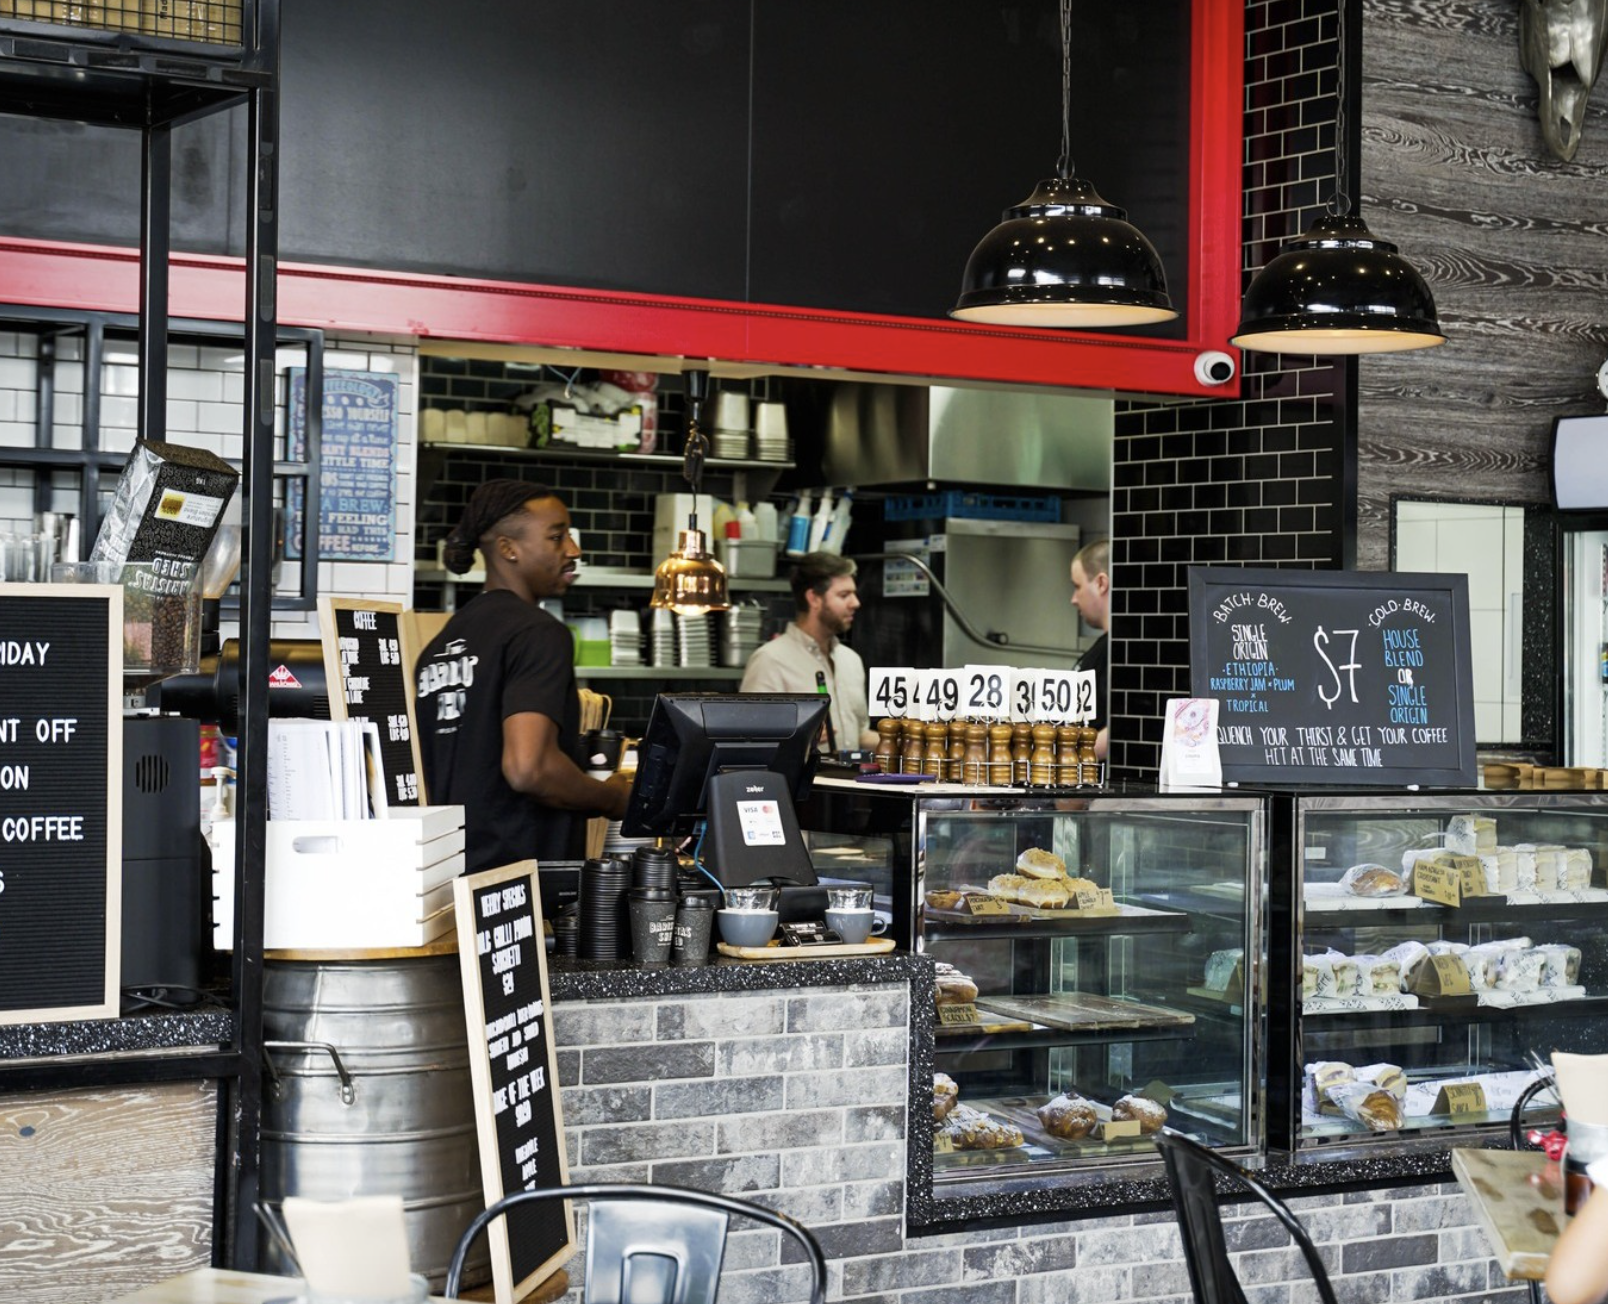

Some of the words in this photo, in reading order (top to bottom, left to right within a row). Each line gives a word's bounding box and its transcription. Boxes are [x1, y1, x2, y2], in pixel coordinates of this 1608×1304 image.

[1213, 592, 1251, 624] BATCH
[1257, 592, 1291, 625] BREW
[1369, 599, 1399, 627] COLD
[1403, 598, 1436, 624] BREW
[1231, 624, 1268, 642] SINGLE
[1383, 629, 1421, 649] HOUSE
[1233, 642, 1268, 660] ORIGIN
[1385, 650, 1424, 668] BLEND
[1313, 625, 1362, 710] $7
[876, 676, 908, 709] 45
[926, 678, 959, 711] 49
[968, 674, 1003, 708] 28
[1041, 678, 1071, 713] 50
[1210, 677, 1249, 691] RASPBERRY
[1273, 677, 1295, 691] PLUM
[1388, 685, 1428, 706] SINGLE
[1016, 680, 1036, 714] 3
[1226, 699, 1269, 713] TROPICAL
[1390, 707, 1428, 725] ORIGIN
[36, 718, 78, 743] OFF
[1260, 726, 1289, 747] YOUR
[1296, 726, 1333, 746] THIRST
[1336, 726, 1347, 746] &
[1351, 726, 1371, 746] GET
[1377, 726, 1408, 745] YOUR
[1412, 727, 1449, 744] COFFEE
[1265, 747, 1287, 766] HIT
[1290, 746, 1303, 766] AT
[1308, 747, 1329, 767] THE
[1333, 748, 1358, 767] SAME
[0, 765, 30, 790] ON
[2, 816, 84, 842] COFFEE
